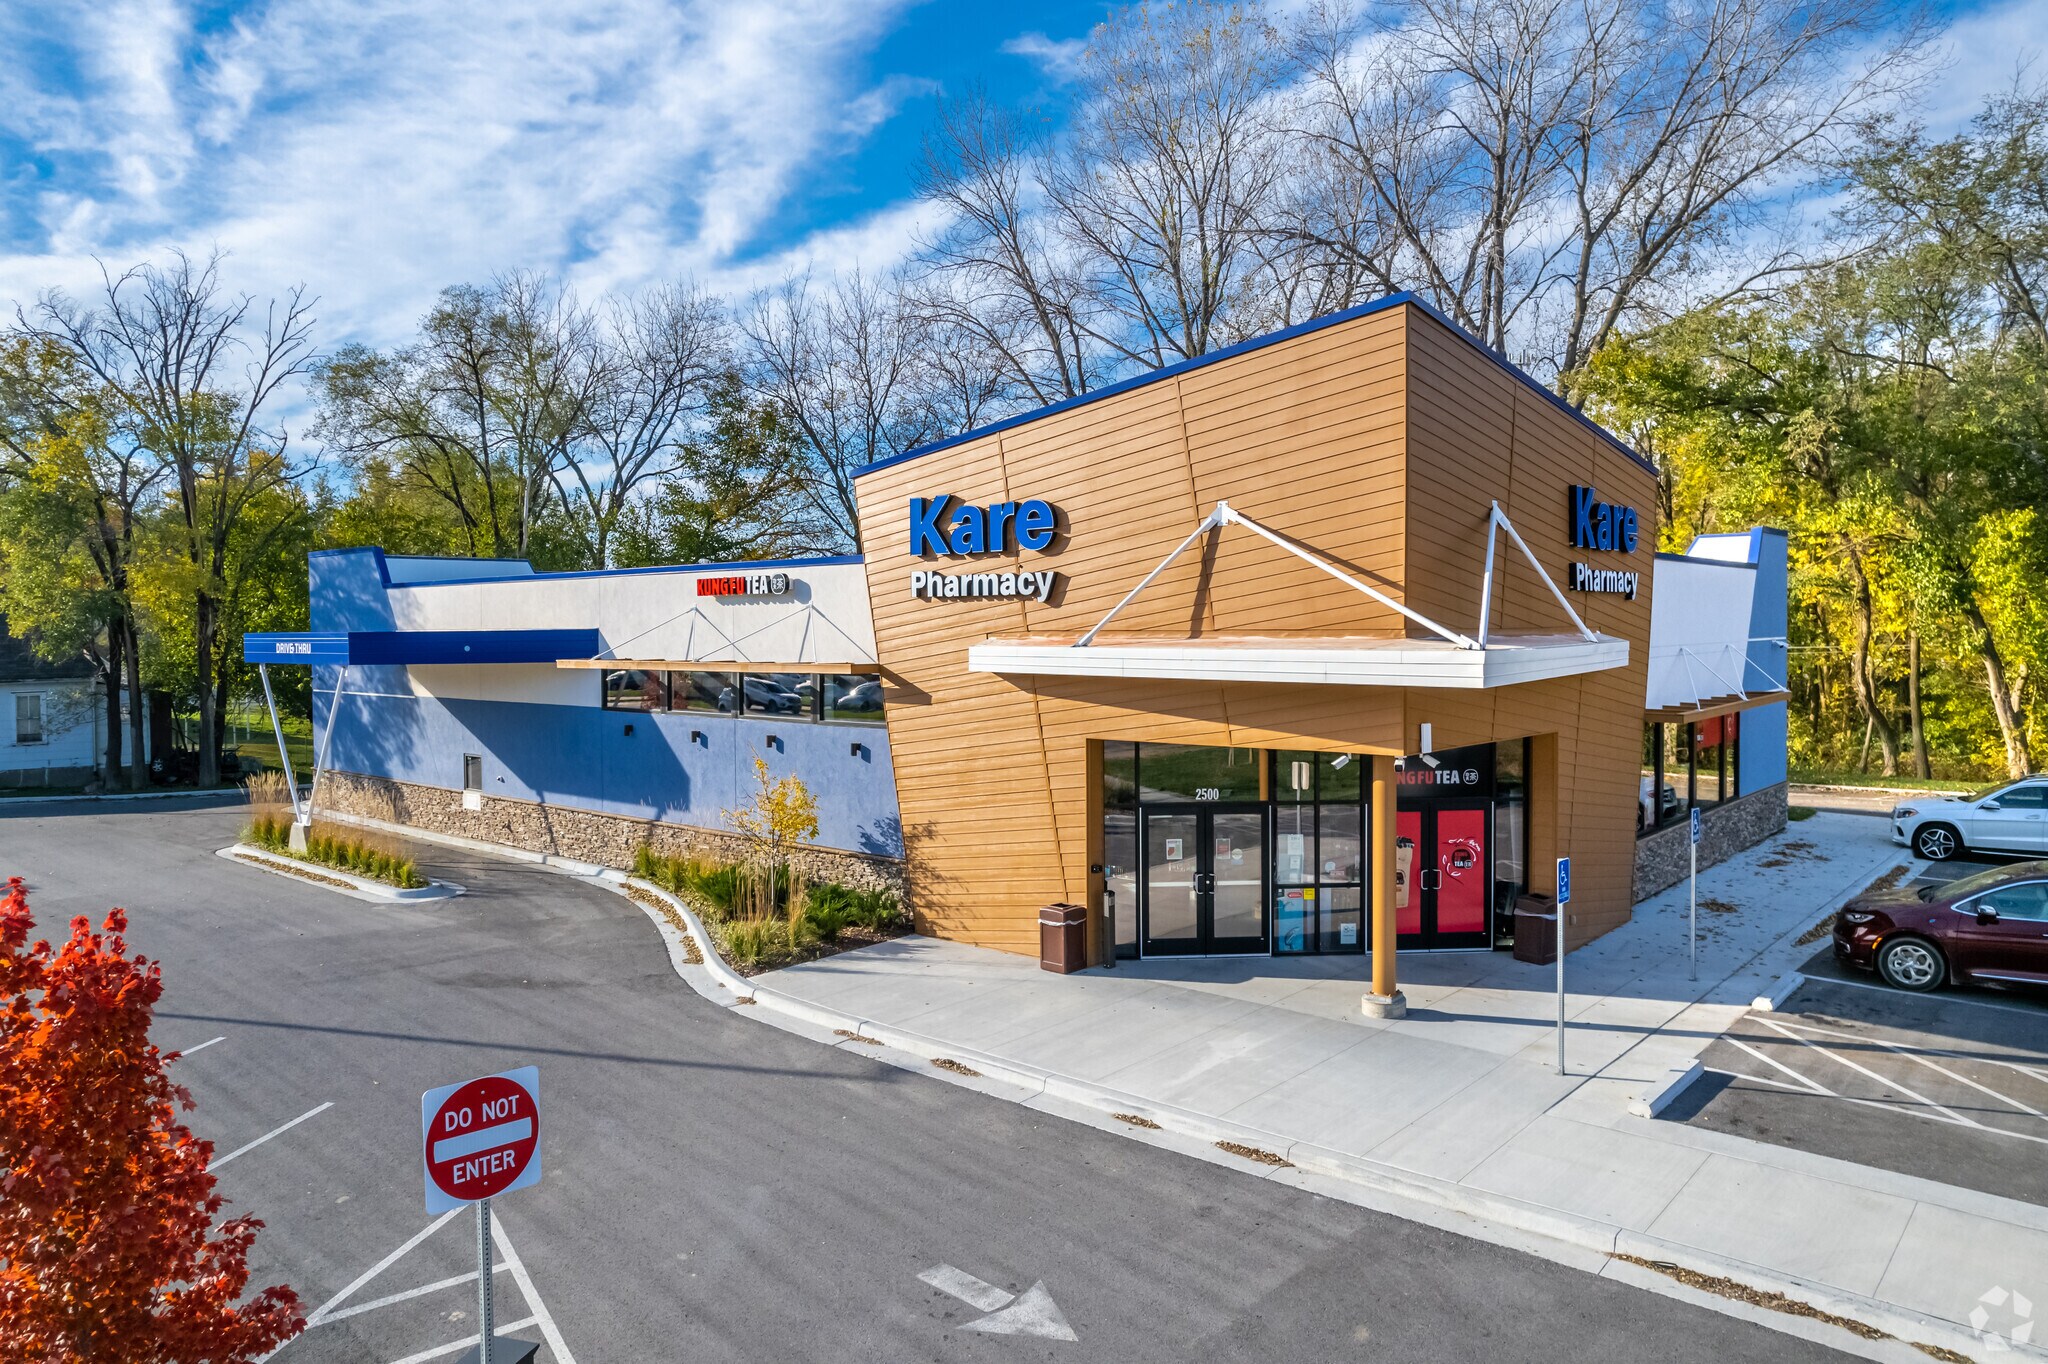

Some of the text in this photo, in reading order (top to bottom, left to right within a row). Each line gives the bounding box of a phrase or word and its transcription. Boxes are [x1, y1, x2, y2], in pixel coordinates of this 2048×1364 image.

[910, 494, 1058, 557] Kare
[1574, 484, 1638, 554] Kare
[745, 575, 768, 595] TEA
[911, 570, 1056, 603] Pharmacy
[1575, 562, 1638, 600] Pharmacy
[1195, 788, 1219, 801] 2500
[1434, 769, 1460, 785] TEA
[445, 1094, 520, 1132] DO NOT
[453, 1149, 516, 1185] ENTER
